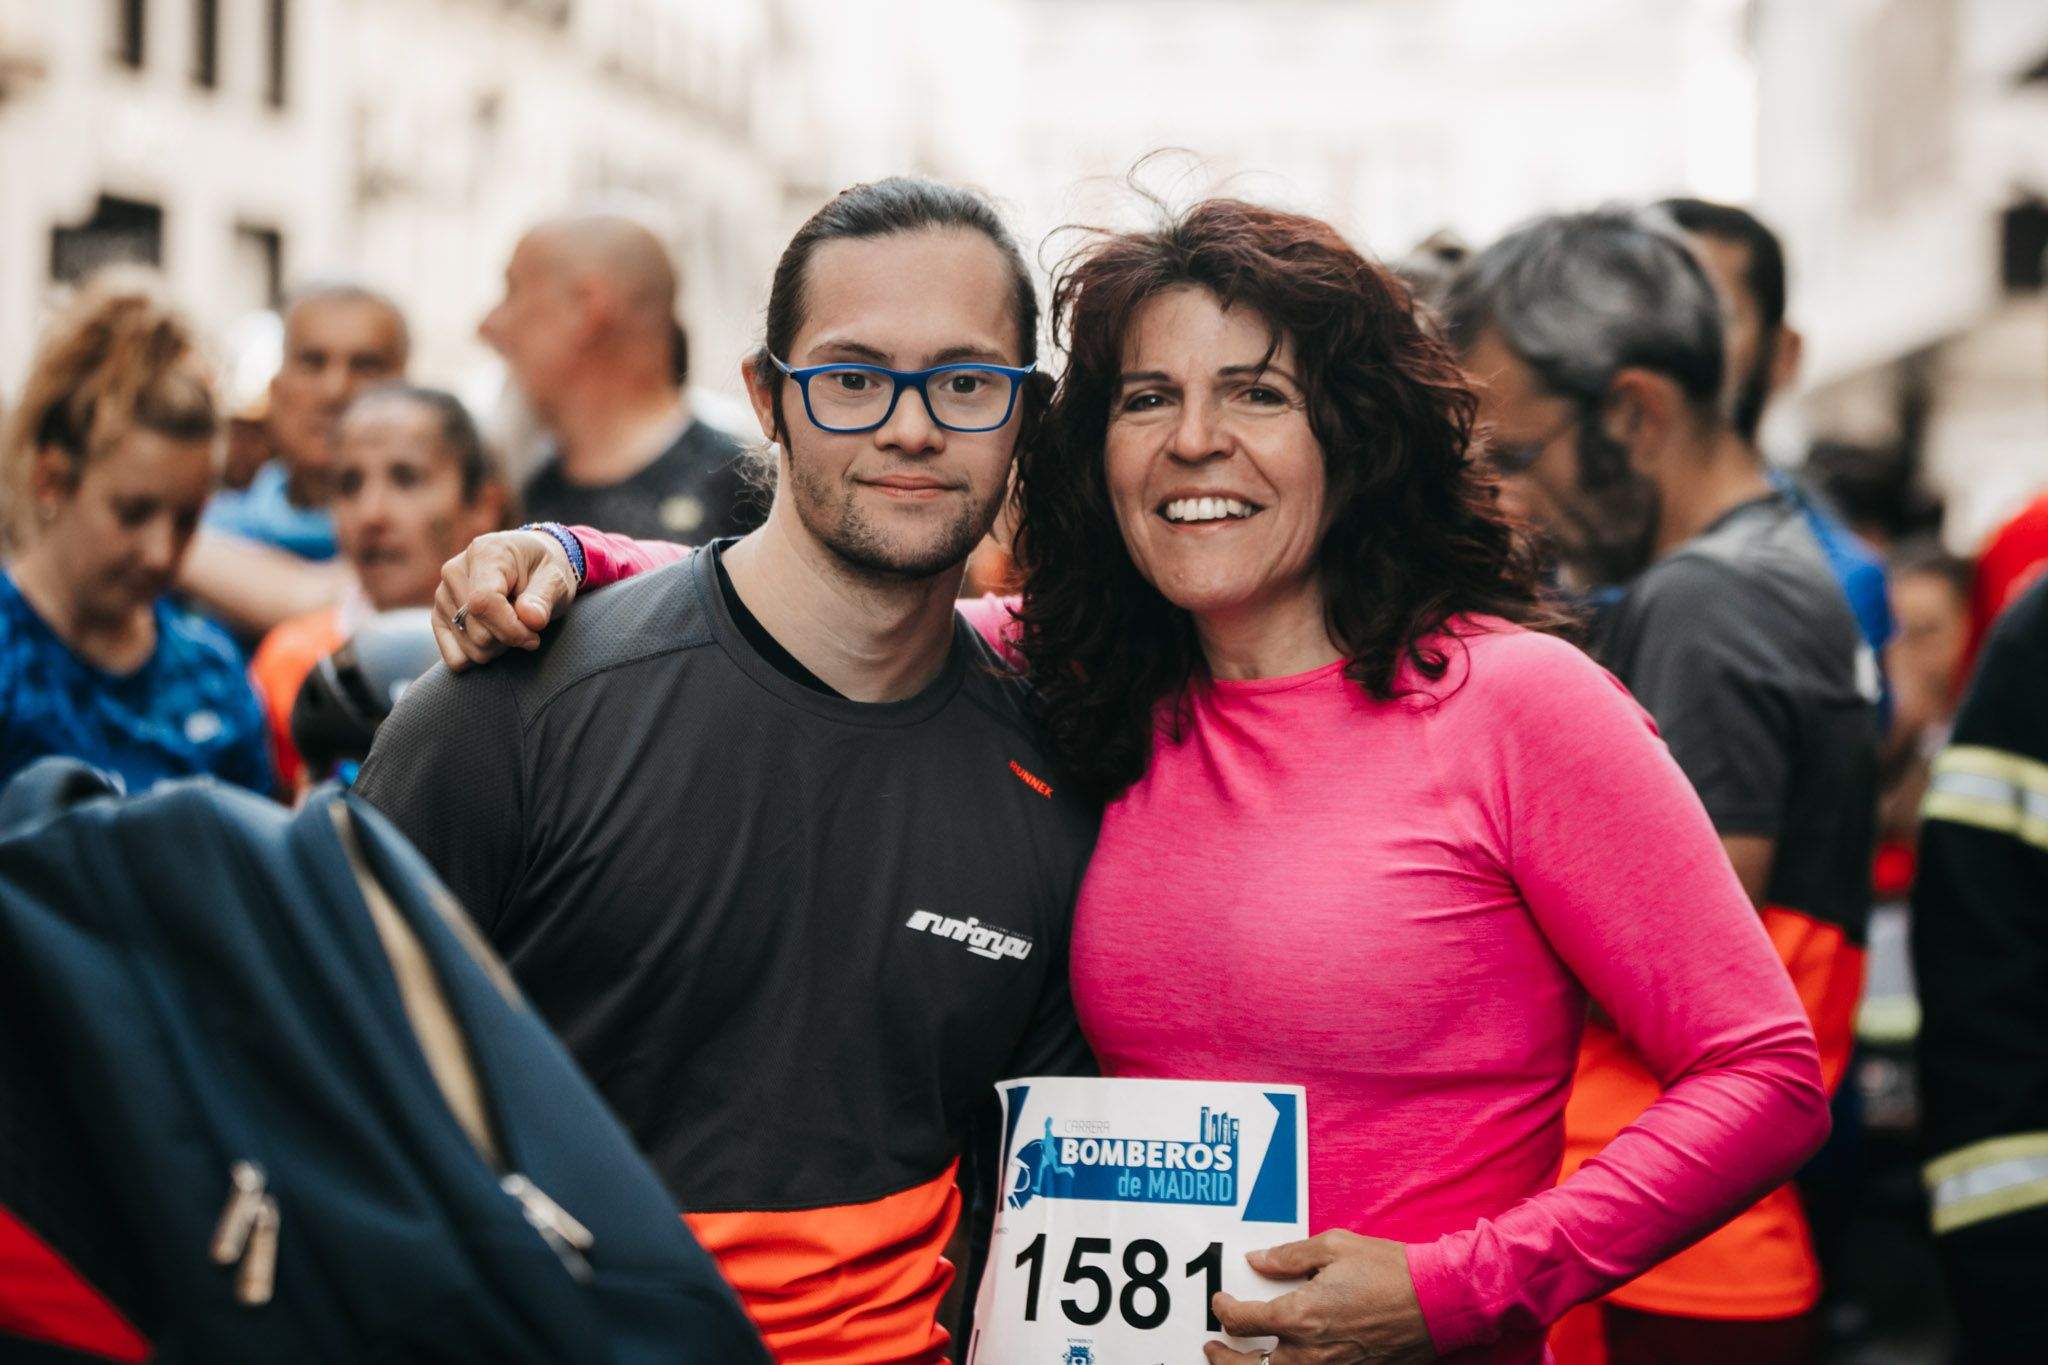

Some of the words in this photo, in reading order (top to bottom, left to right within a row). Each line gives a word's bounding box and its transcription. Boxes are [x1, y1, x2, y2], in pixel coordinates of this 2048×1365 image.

[1064, 1120, 1111, 1133] CARRERA
[1061, 1138, 1233, 1171] BOMBEROS
[1118, 1169, 1141, 1197] de
[1148, 1170, 1233, 1202] MADRID
[1015, 1233, 1223, 1332] 1581
